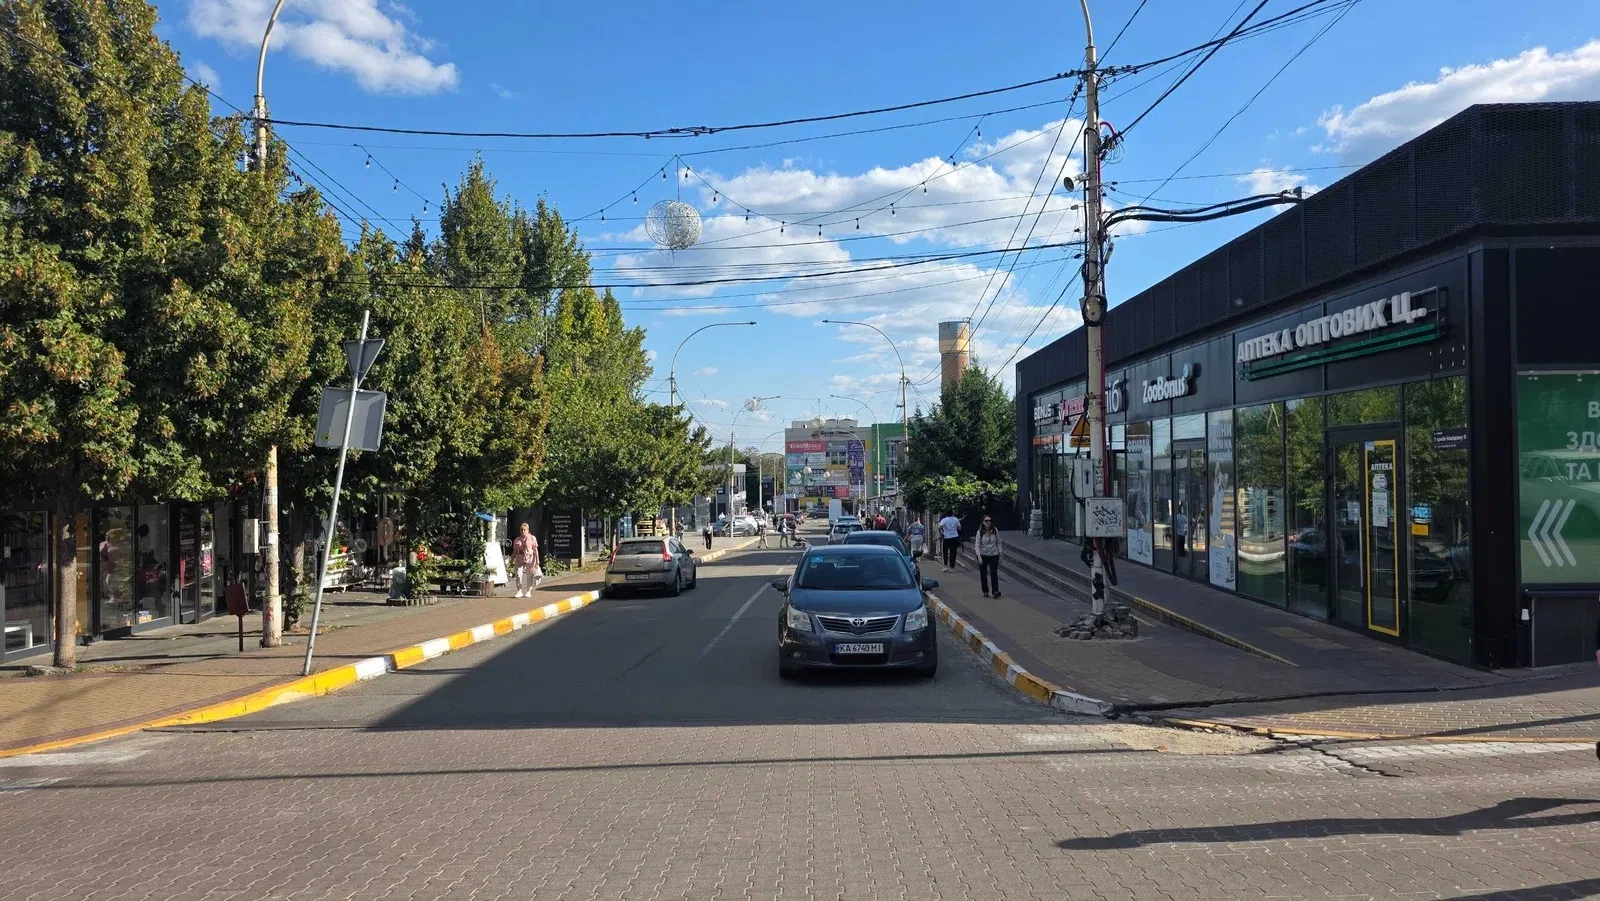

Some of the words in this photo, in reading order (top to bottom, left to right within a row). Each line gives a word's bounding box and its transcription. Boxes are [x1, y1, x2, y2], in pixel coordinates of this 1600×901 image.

[1237, 327, 1294, 364] АПТЕКА
[1295, 298, 1389, 348] ОПТОВИХ
[1370, 463, 1393, 471] АПТЕКА
[1565, 462, 1592, 481] ТА
